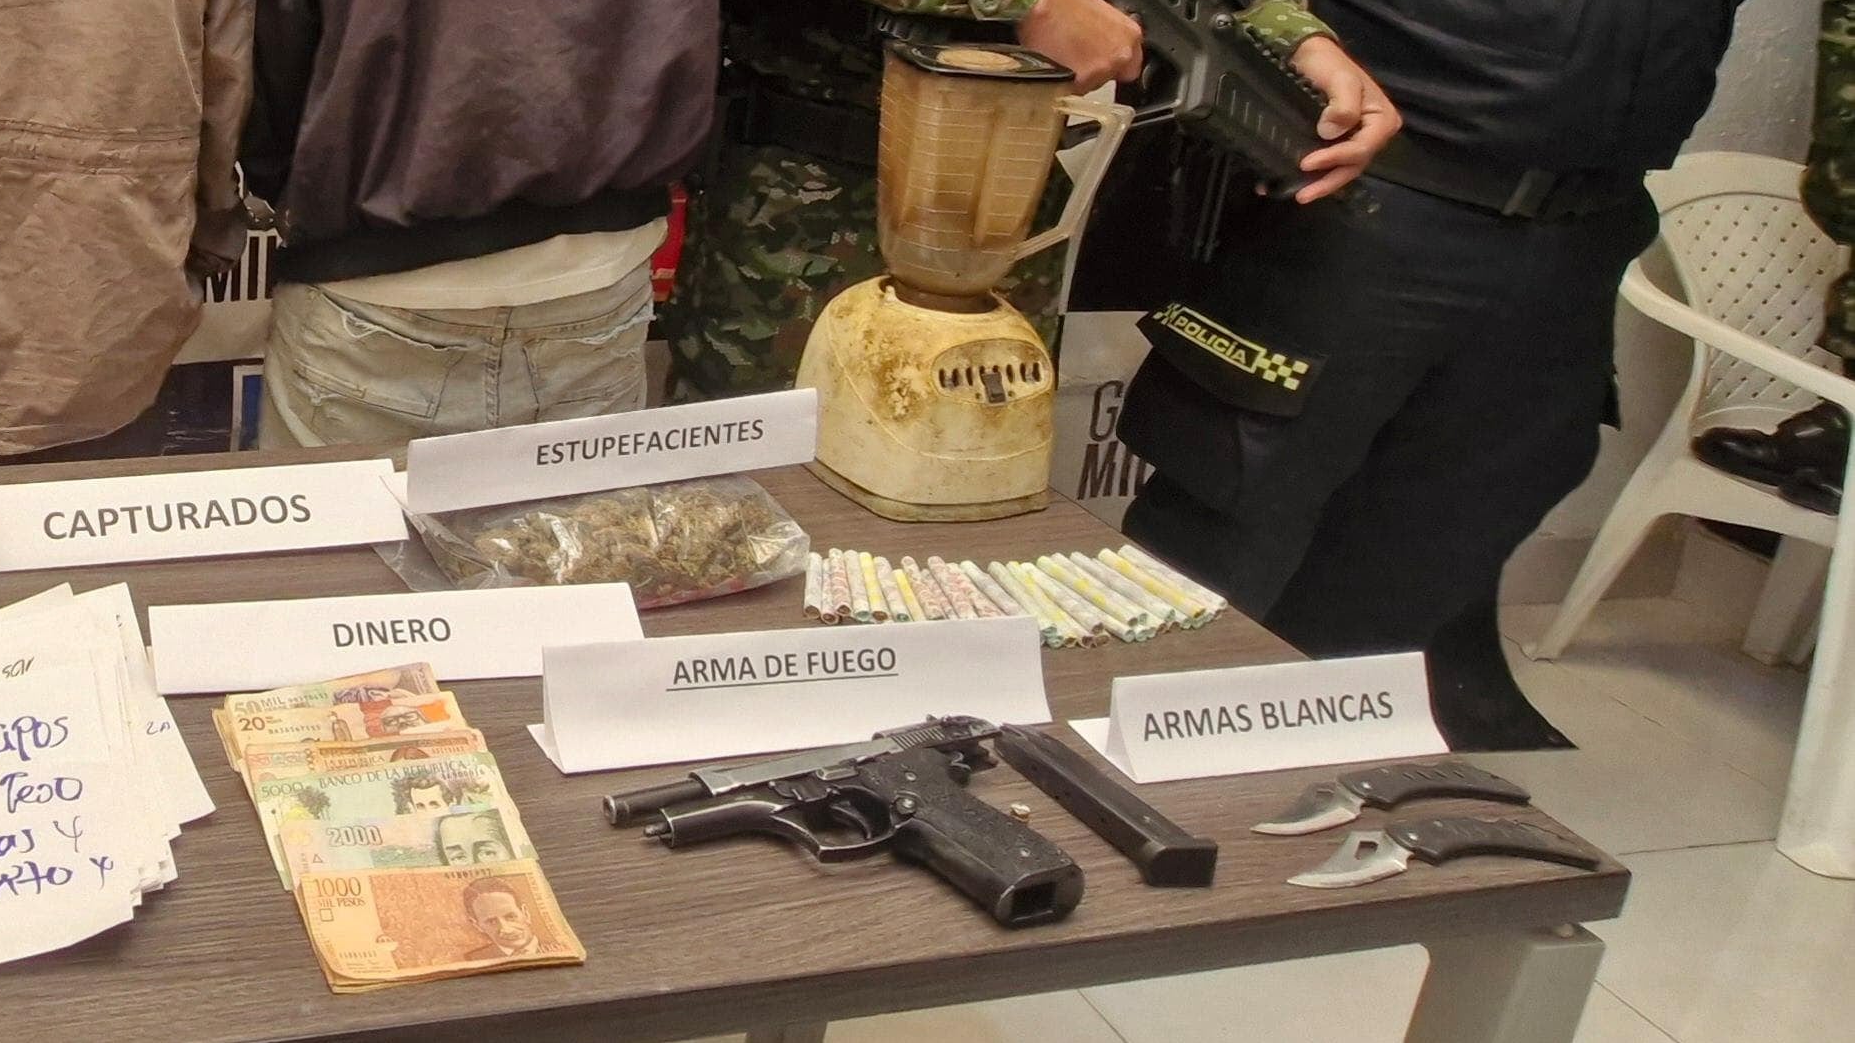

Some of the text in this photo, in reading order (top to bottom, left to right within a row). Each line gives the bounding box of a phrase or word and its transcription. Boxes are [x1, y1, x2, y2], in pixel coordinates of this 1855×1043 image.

[1174, 315, 1247, 364] POLICÍA
[535, 419, 765, 466] ESTUPEFACIENTES
[44, 493, 312, 541] CAPTURADOS
[333, 617, 451, 648] DINERO
[673, 647, 897, 685] ARMA DE FUEGO
[238, 717, 265, 731] 20
[1143, 690, 1394, 743] ARMAS BLANCAS
[261, 781, 304, 799] 5000
[319, 773, 362, 789] BANCO
[367, 770, 384, 783] DE
[386, 768, 403, 780] LA
[326, 825, 383, 847] 2000
[313, 877, 362, 898] 1000
